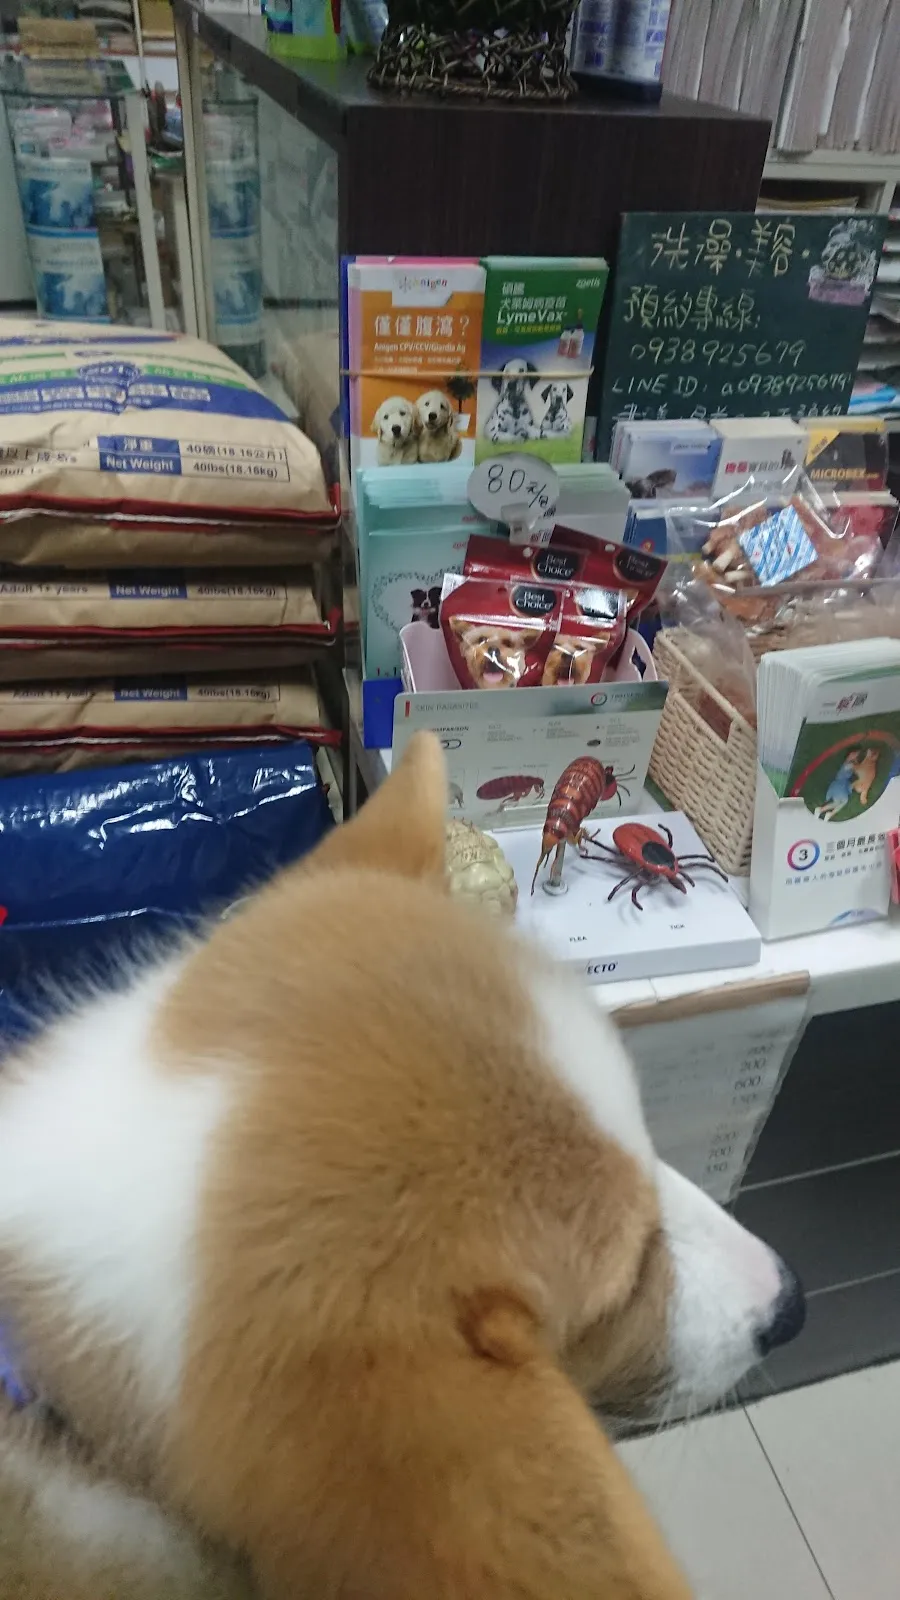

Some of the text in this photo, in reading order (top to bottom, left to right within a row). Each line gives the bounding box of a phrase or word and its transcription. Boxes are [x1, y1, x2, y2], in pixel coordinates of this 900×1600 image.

[576, 277, 600, 289] zoetis
[611, 373, 668, 395] LINE
[106, 456, 174, 472] Net Weight
[192, 463, 278, 479] 40lbs(18.16kg)
[546, 554, 567, 565] Best
[115, 584, 179, 597] Net Weight
[523, 591, 545, 601] Best
[515, 597, 552, 611] Choice
[121, 688, 180, 699] Net Weight
[798, 848, 808, 861] 3
[569, 935, 587, 943] FLEA
